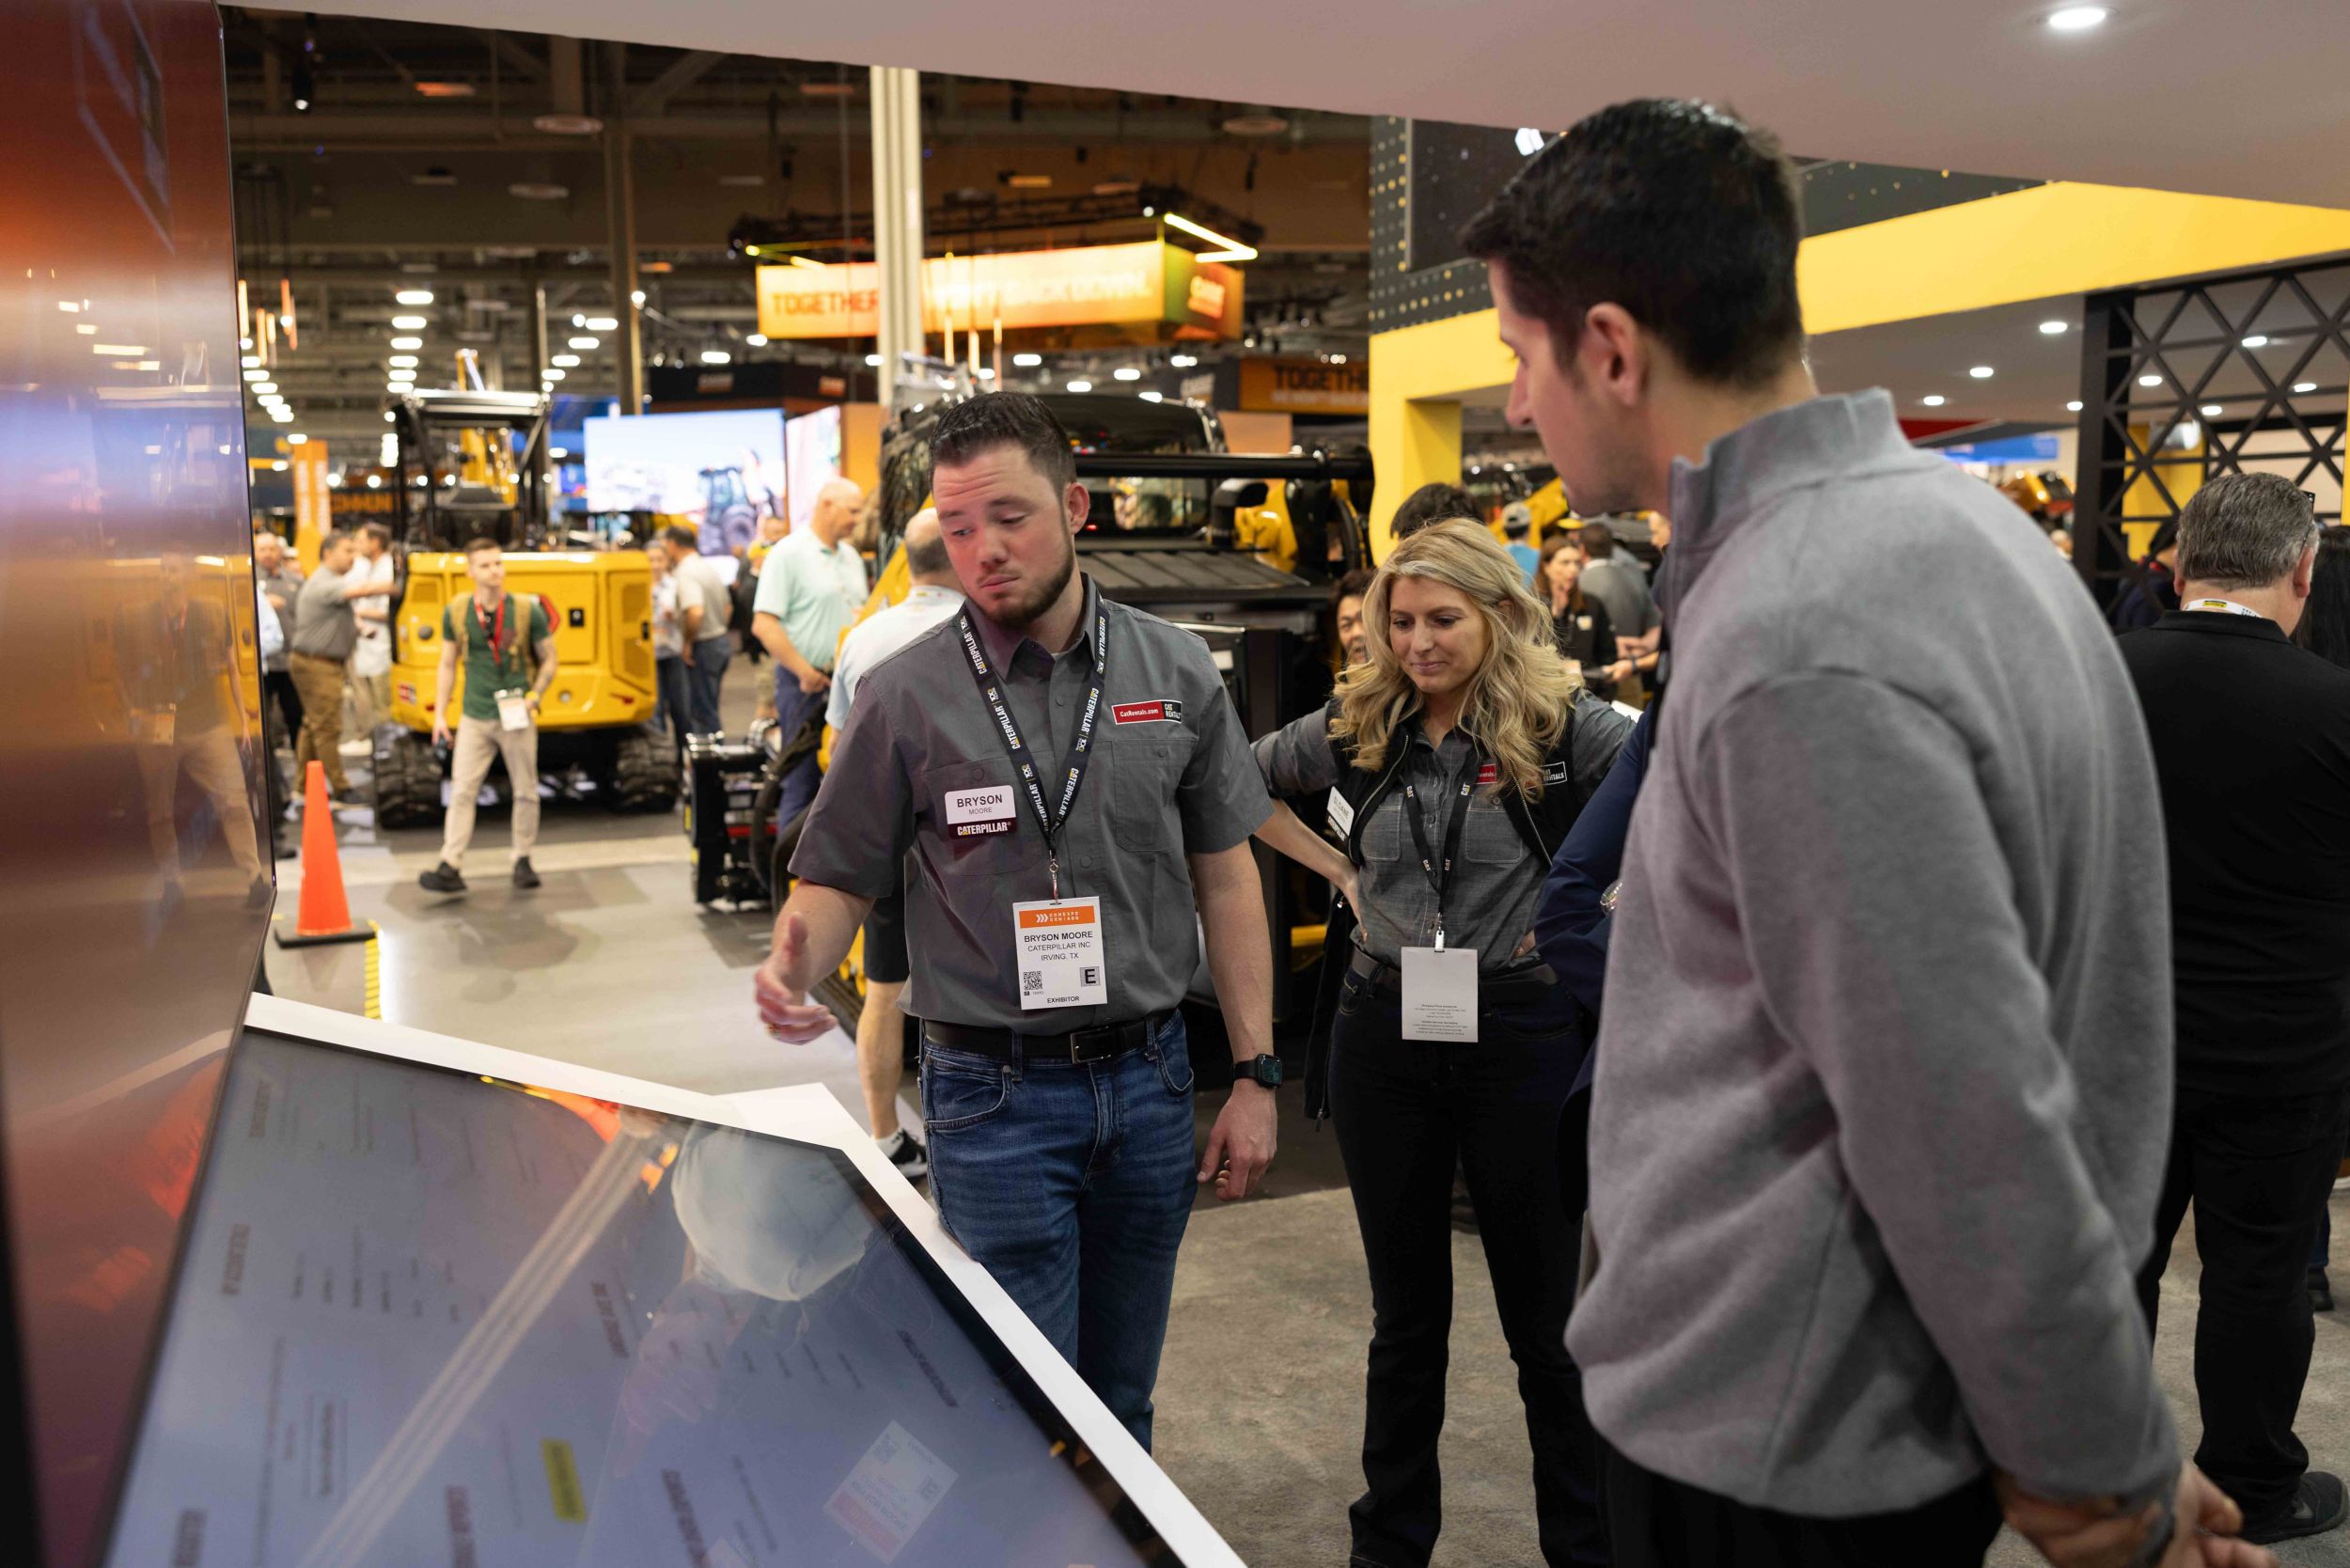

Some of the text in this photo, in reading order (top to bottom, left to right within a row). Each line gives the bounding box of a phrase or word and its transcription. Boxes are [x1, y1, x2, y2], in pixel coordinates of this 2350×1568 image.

[964, 631, 987, 675] CATERPILLAR
[1080, 687, 1099, 734] CATERPILLAR
[995, 705, 1021, 750] CATERPILLAR
[1058, 767, 1079, 817] CATERPILLAR
[1406, 785, 1415, 798] CAT
[1460, 781, 1471, 796] CAT
[957, 794, 1003, 808] BRYSON
[957, 822, 1008, 836] CATERPILLAR
[1422, 859, 1432, 871] CAT
[1024, 931, 1093, 943] BRYSON MOORE
[1027, 943, 1076, 952] CATERPILLAR
[1085, 968, 1096, 984] E
